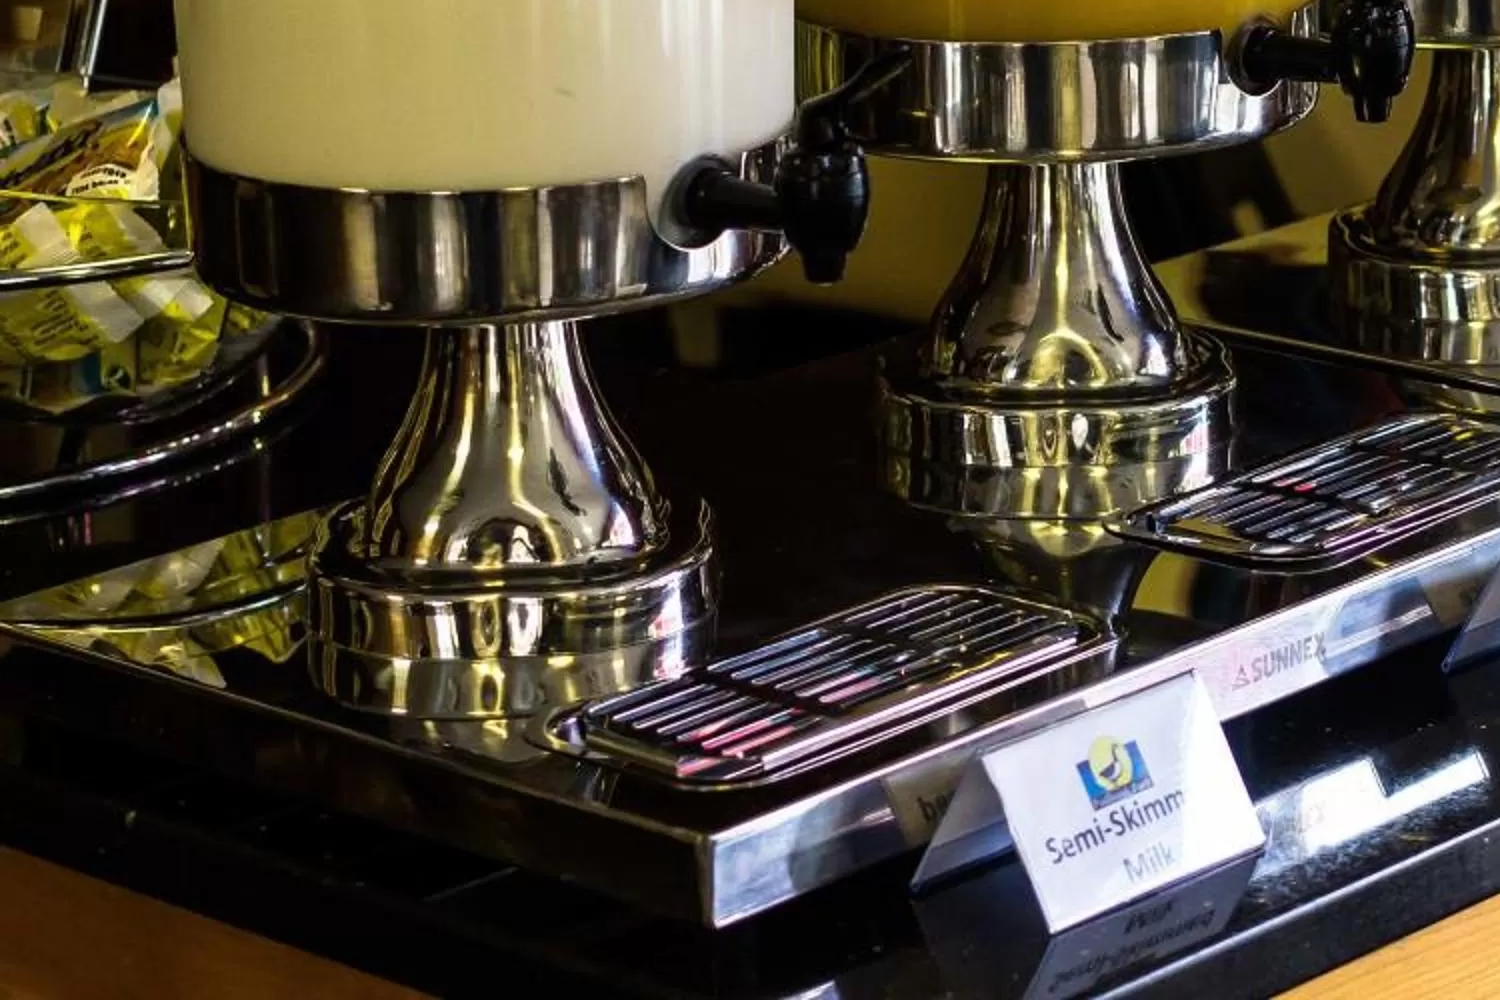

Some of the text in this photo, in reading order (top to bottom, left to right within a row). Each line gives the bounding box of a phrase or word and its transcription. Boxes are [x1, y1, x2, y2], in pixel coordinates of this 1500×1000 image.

[1251, 632, 1327, 682] SUNNEX
[1044, 789, 1185, 865] Semi-Skimm
[1121, 841, 1176, 883] Milk
